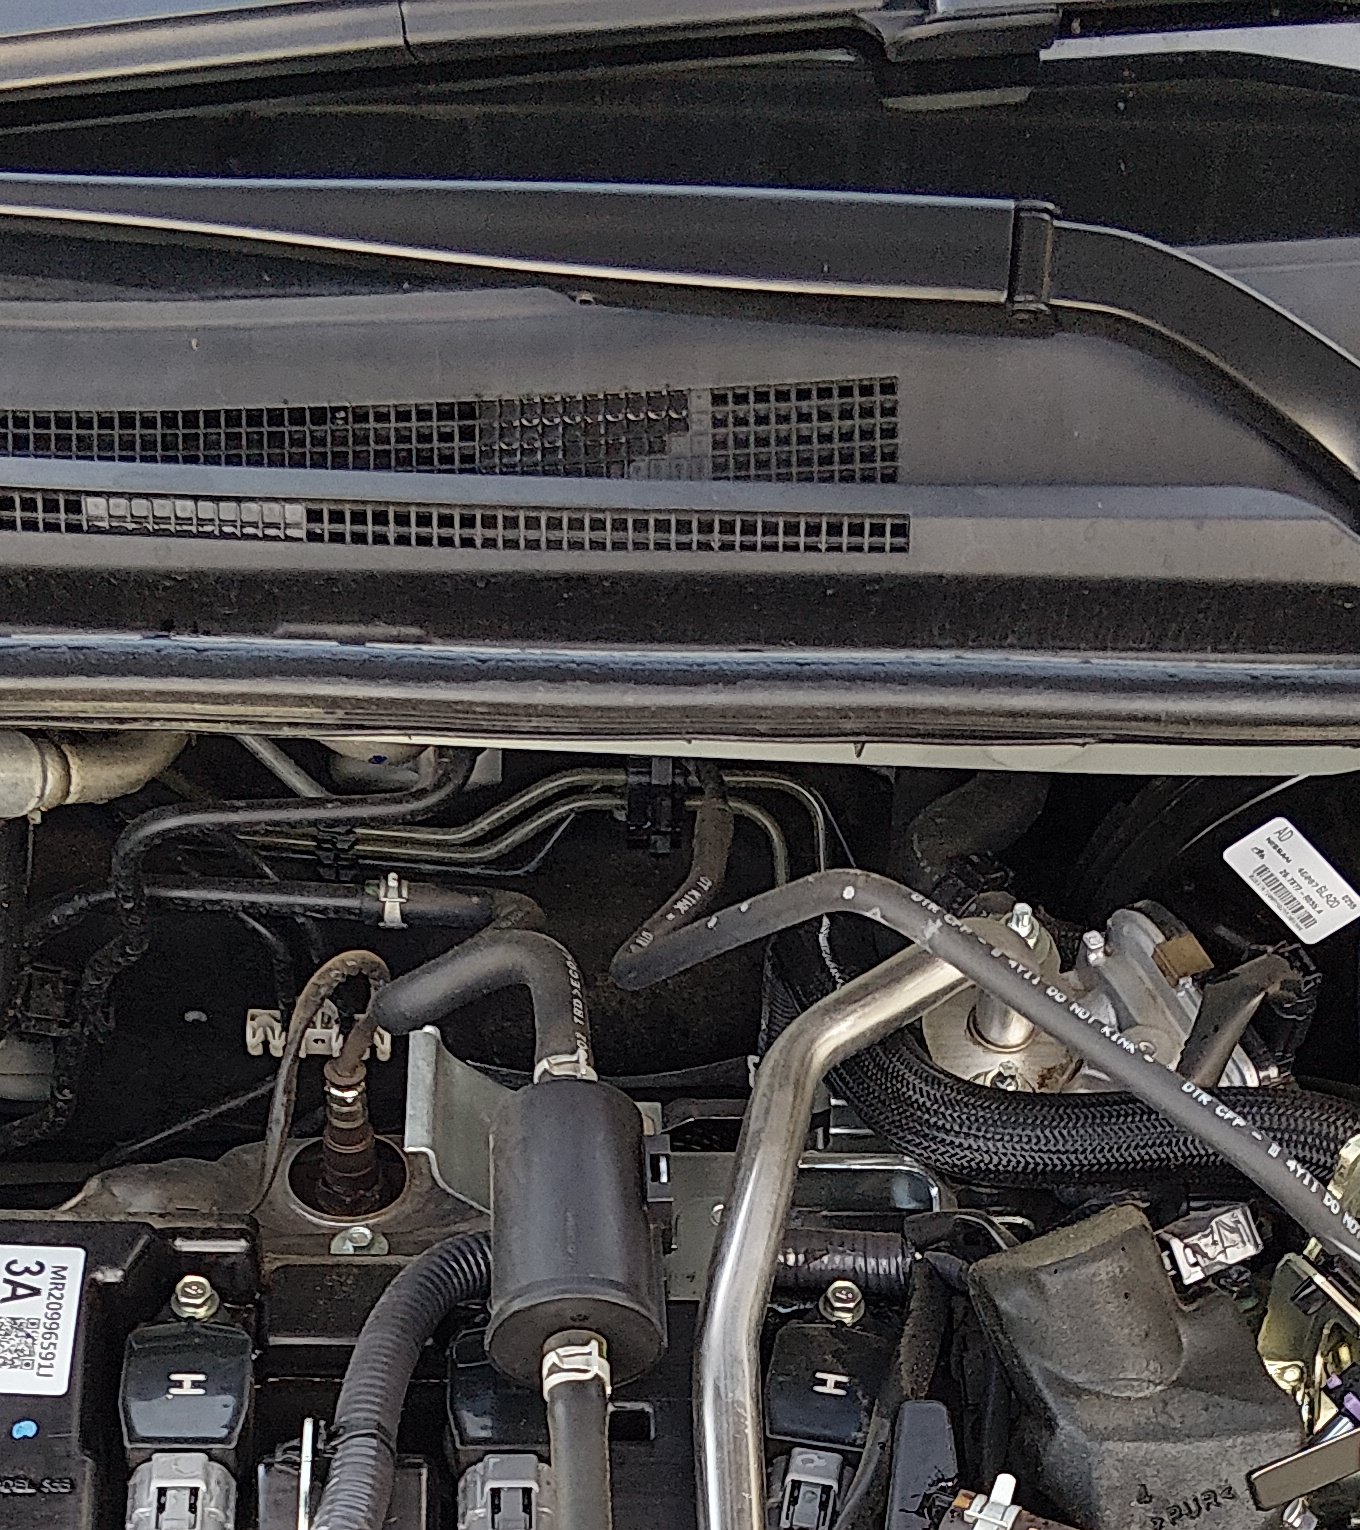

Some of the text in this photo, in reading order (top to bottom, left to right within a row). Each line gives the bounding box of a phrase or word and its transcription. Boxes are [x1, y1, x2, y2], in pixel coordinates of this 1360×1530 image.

[1274, 827, 1294, 842] AD
[1045, 984, 1068, 1005] DO
[1320, 1192, 1344, 1215] DO
[0, 1259, 45, 1304] 3A
